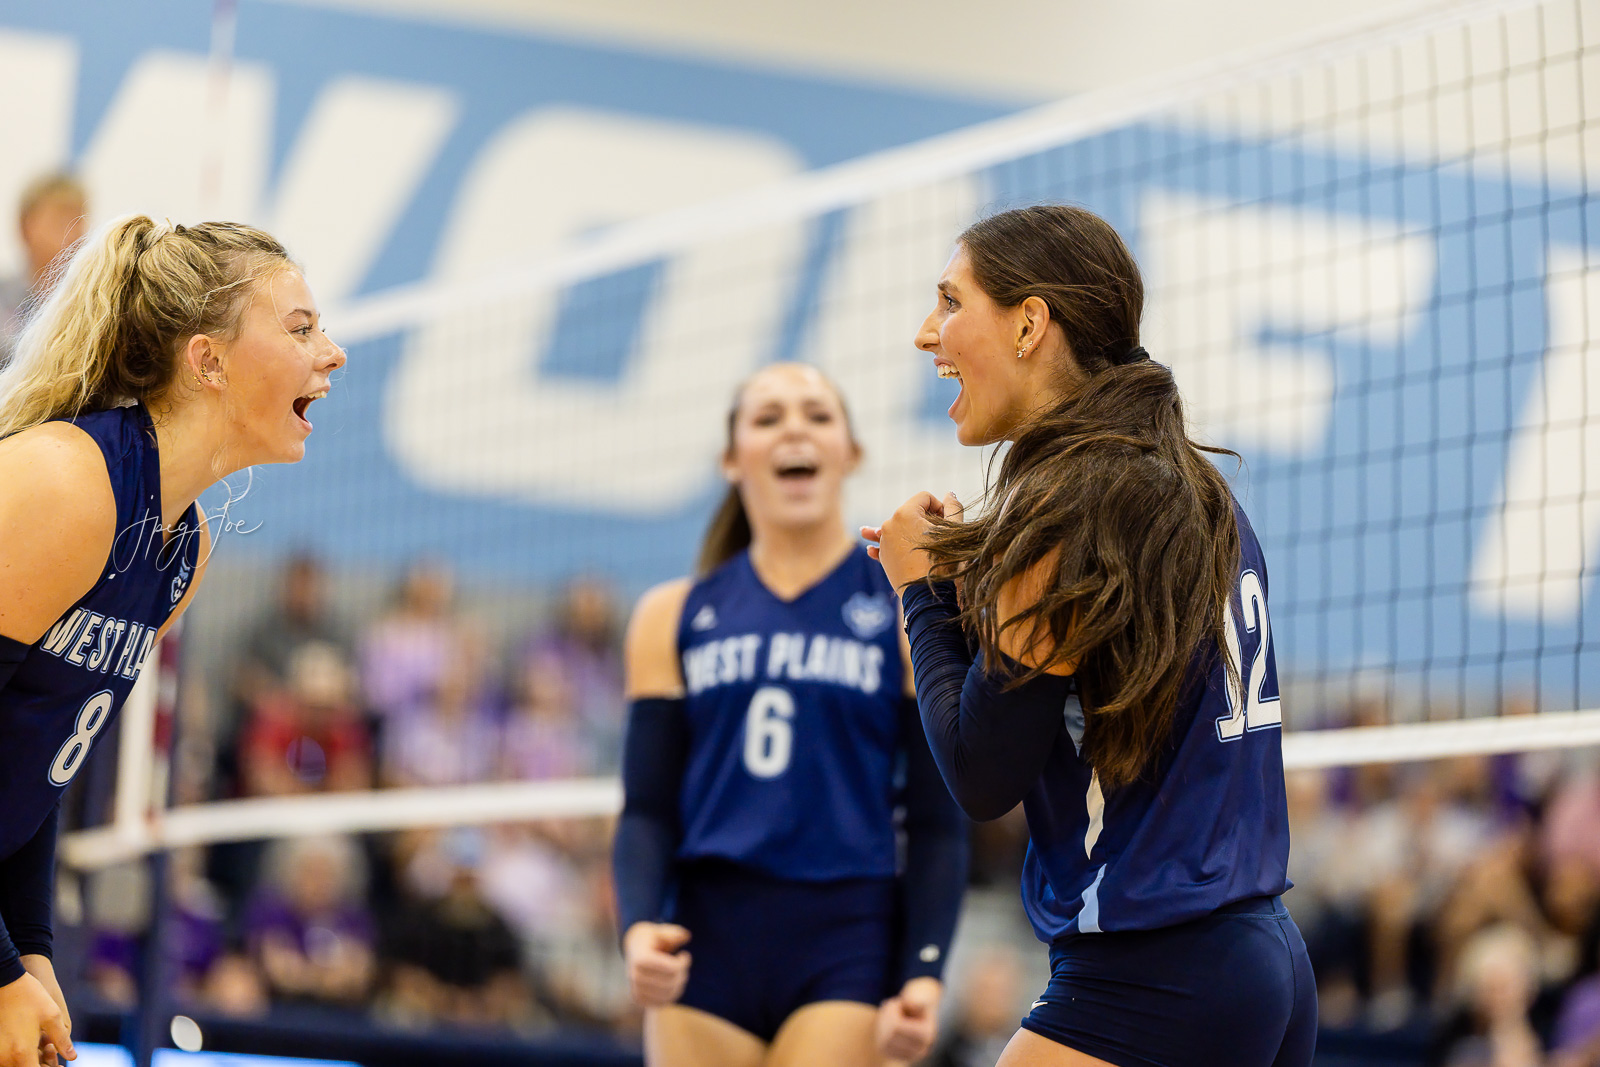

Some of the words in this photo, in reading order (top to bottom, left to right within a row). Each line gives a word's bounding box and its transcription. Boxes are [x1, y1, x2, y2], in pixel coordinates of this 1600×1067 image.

[39, 607, 128, 674] WEST
[682, 632, 762, 695] WEST
[765, 631, 884, 695] PLAINS
[1215, 568, 1282, 743] 12
[47, 688, 114, 787] 8
[742, 685, 796, 780] 6
